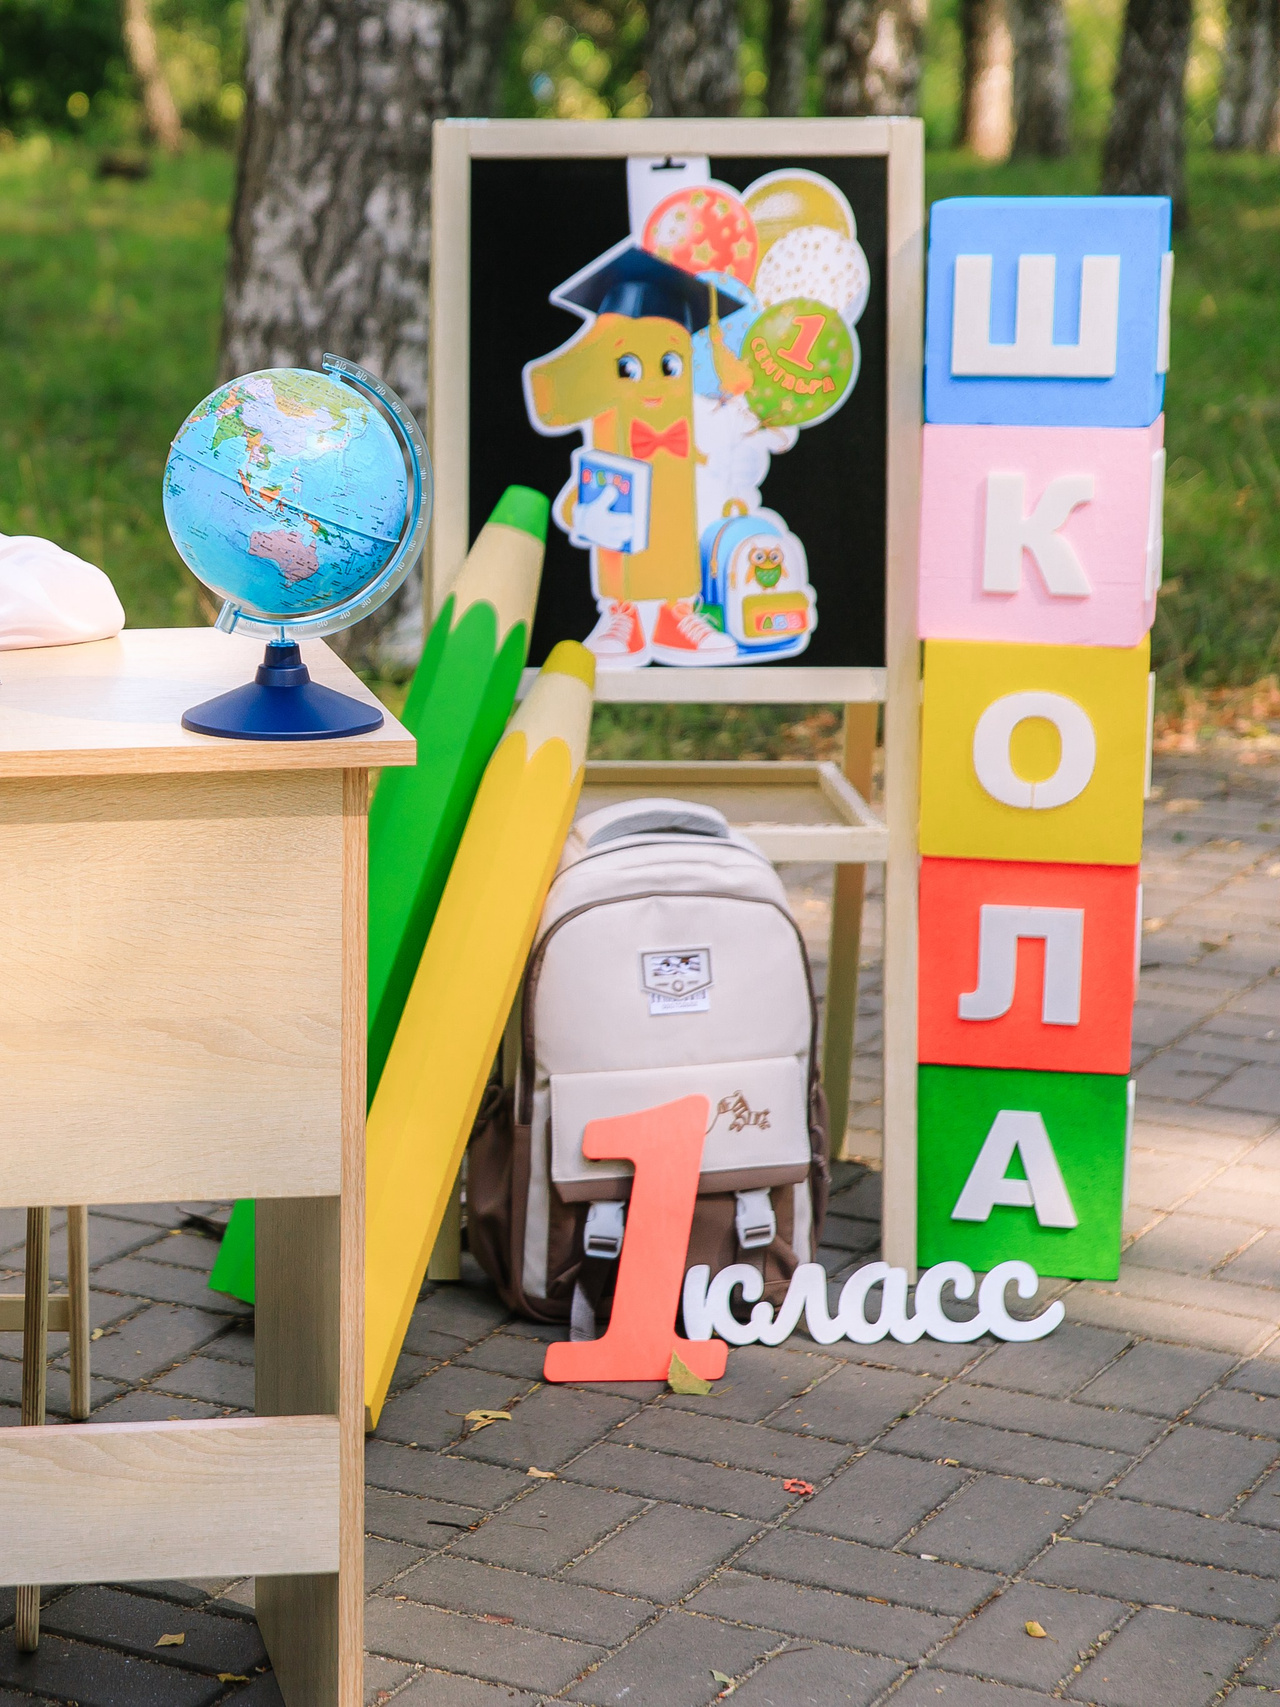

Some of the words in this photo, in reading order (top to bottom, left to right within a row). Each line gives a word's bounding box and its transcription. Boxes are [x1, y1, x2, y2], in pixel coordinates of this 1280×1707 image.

[751, 337, 836, 395] СЕНТЯБРЯ
[776, 313, 826, 371] 1
[543, 1094, 728, 1382] 1
[683, 1260, 1066, 1347] класс
